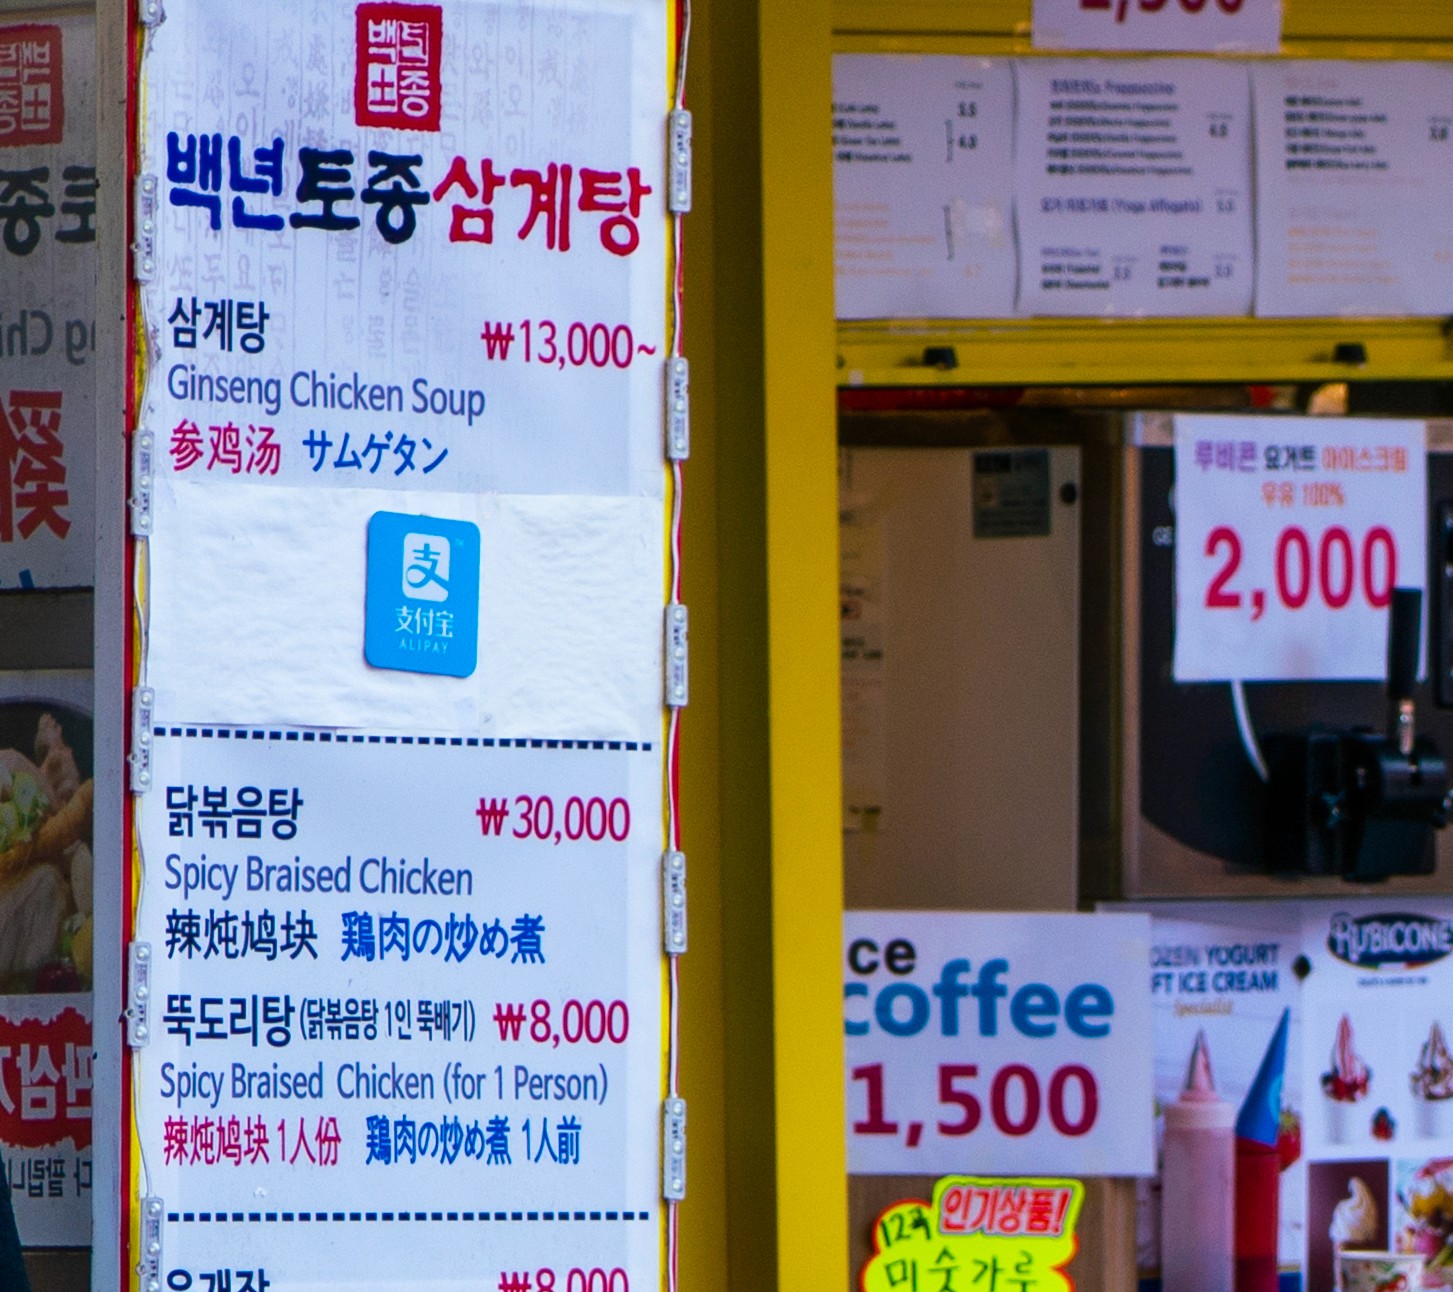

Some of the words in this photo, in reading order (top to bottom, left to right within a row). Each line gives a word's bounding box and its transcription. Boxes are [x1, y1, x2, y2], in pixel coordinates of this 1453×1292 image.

[167, 297, 269, 354] 삼계탕
[167, 363, 281, 415] Ginseng
[290, 370, 402, 412] Chicken
[412, 378, 485, 426] Soup
[169, 419, 282, 476] 参鸡汤
[302, 429, 449, 476] サムゲタン
[1204, 524, 1397, 622] 2,000
[395, 606, 455, 638] 支付宝
[399, 638, 449, 655] ALIPAY
[165, 785, 303, 840] 닭볶음탕
[165, 853, 238, 901] Spicy
[247, 856, 351, 893] Braised
[359, 857, 473, 896] Chicken
[341, 910, 546, 964] 鶏肉の炒め煮
[847, 937, 917, 976] ce
[1206, 943, 1280, 966] YOGURT
[844, 957, 1115, 1039] coffee
[1212, 970, 1279, 993] CREAM
[162, 994, 296, 1047] 뚝도리탕
[416, 1000, 476, 1043] 뚝배기)
[160, 1061, 225, 1109] Spicy
[231, 1061, 324, 1100] Braised
[336, 1062, 435, 1100] Chicken
[442, 1062, 486, 1104] (for
[493, 1065, 503, 1099] 1
[513, 1062, 609, 1106] Person)
[852, 1061, 1099, 1149] 1,500
[520, 1115, 582, 1165] 1人前
[942, 1185, 1072, 1236] 인기상품!
